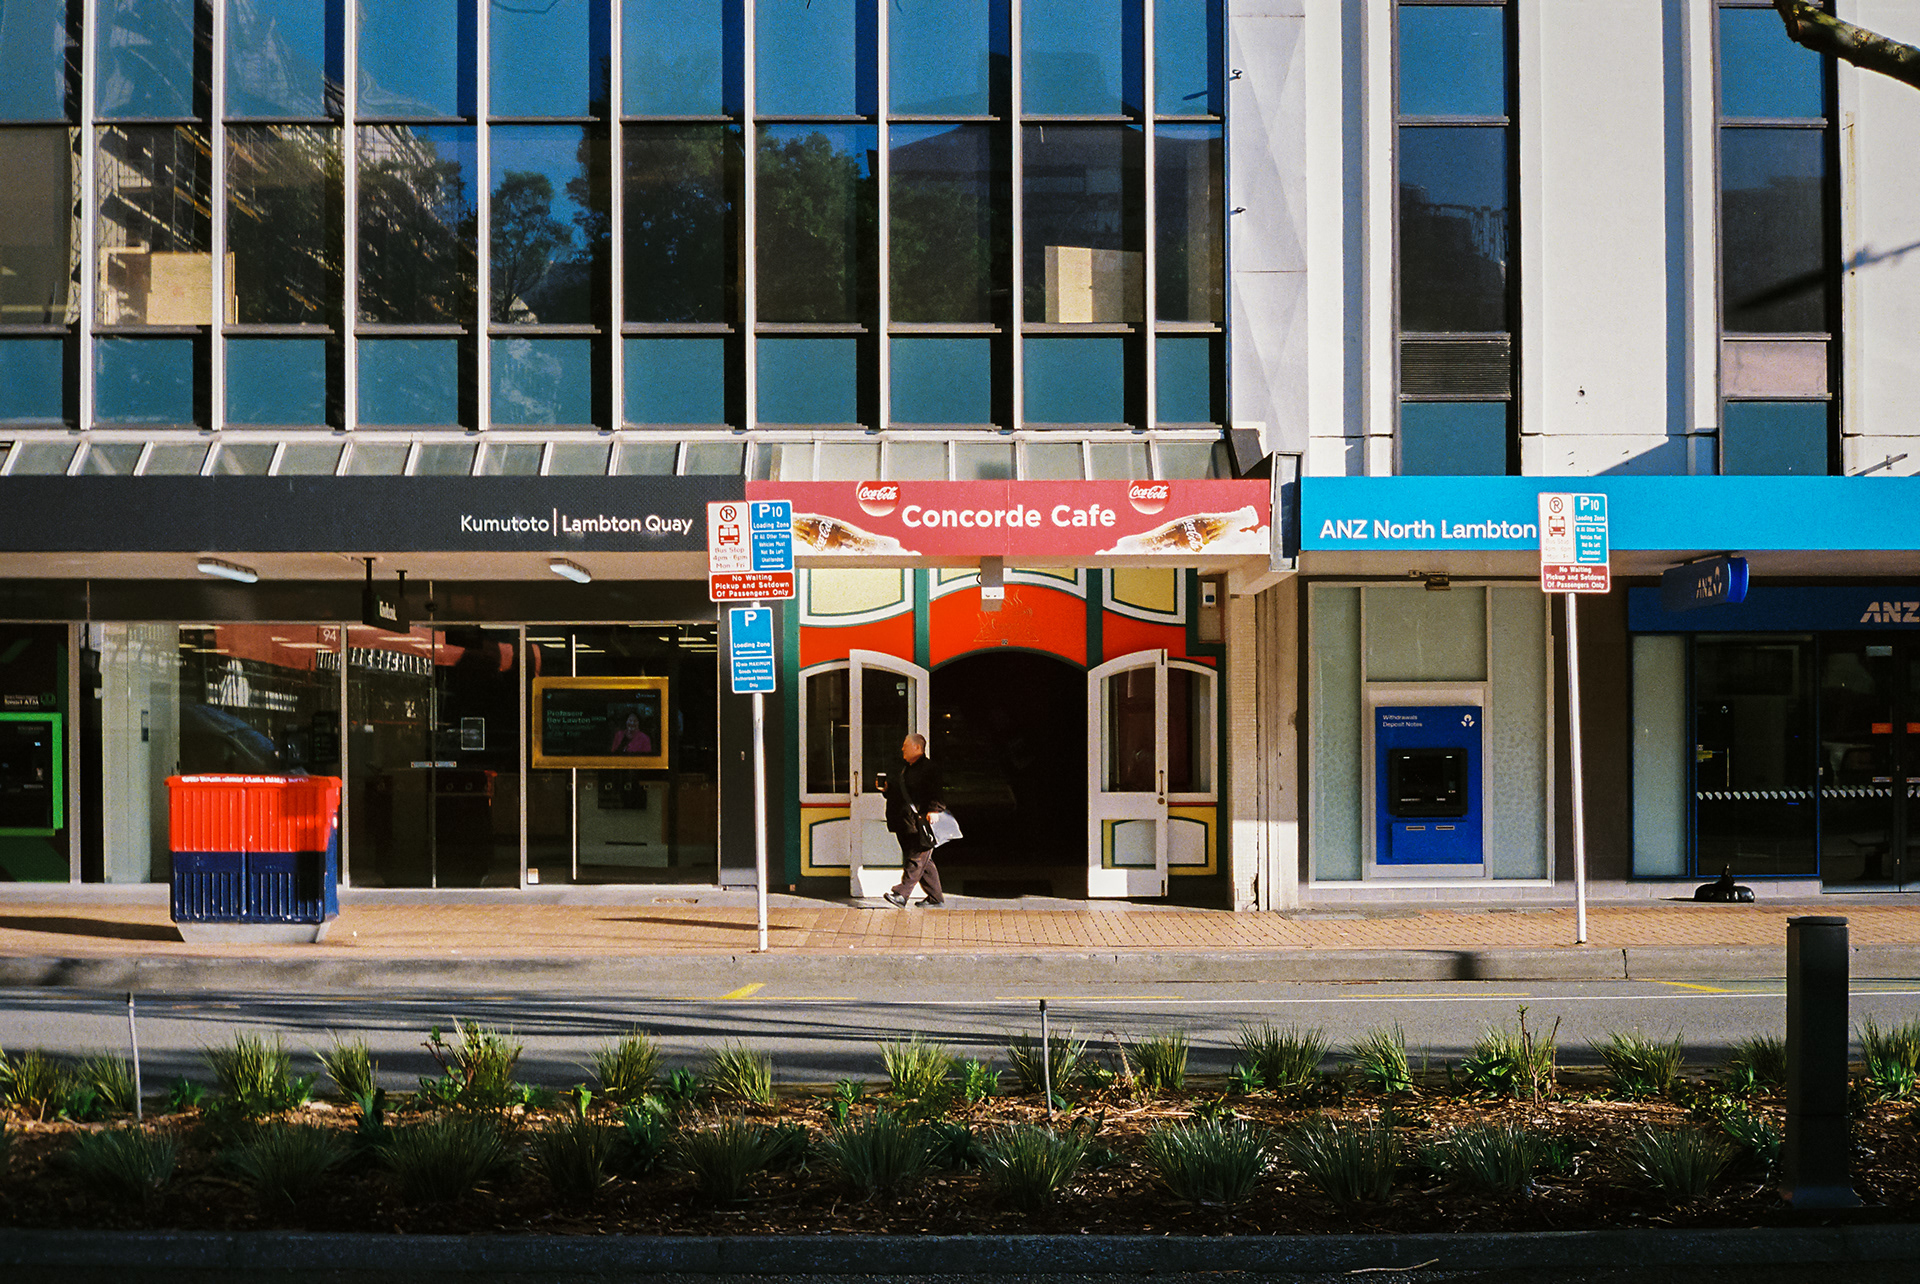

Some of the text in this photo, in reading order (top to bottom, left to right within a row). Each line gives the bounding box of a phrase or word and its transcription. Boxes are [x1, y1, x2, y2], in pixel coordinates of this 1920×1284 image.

[461, 514, 693, 536] Kumutoto Lambton Quay
[902, 505, 1116, 528] Concorde Cafe
[1320, 519, 1537, 539] ANZ North Lambton
[1696, 575, 1713, 599] ANZ
[744, 610, 757, 627] P
[1860, 601, 1920, 623] ANZ
[323, 629, 337, 642] 94
